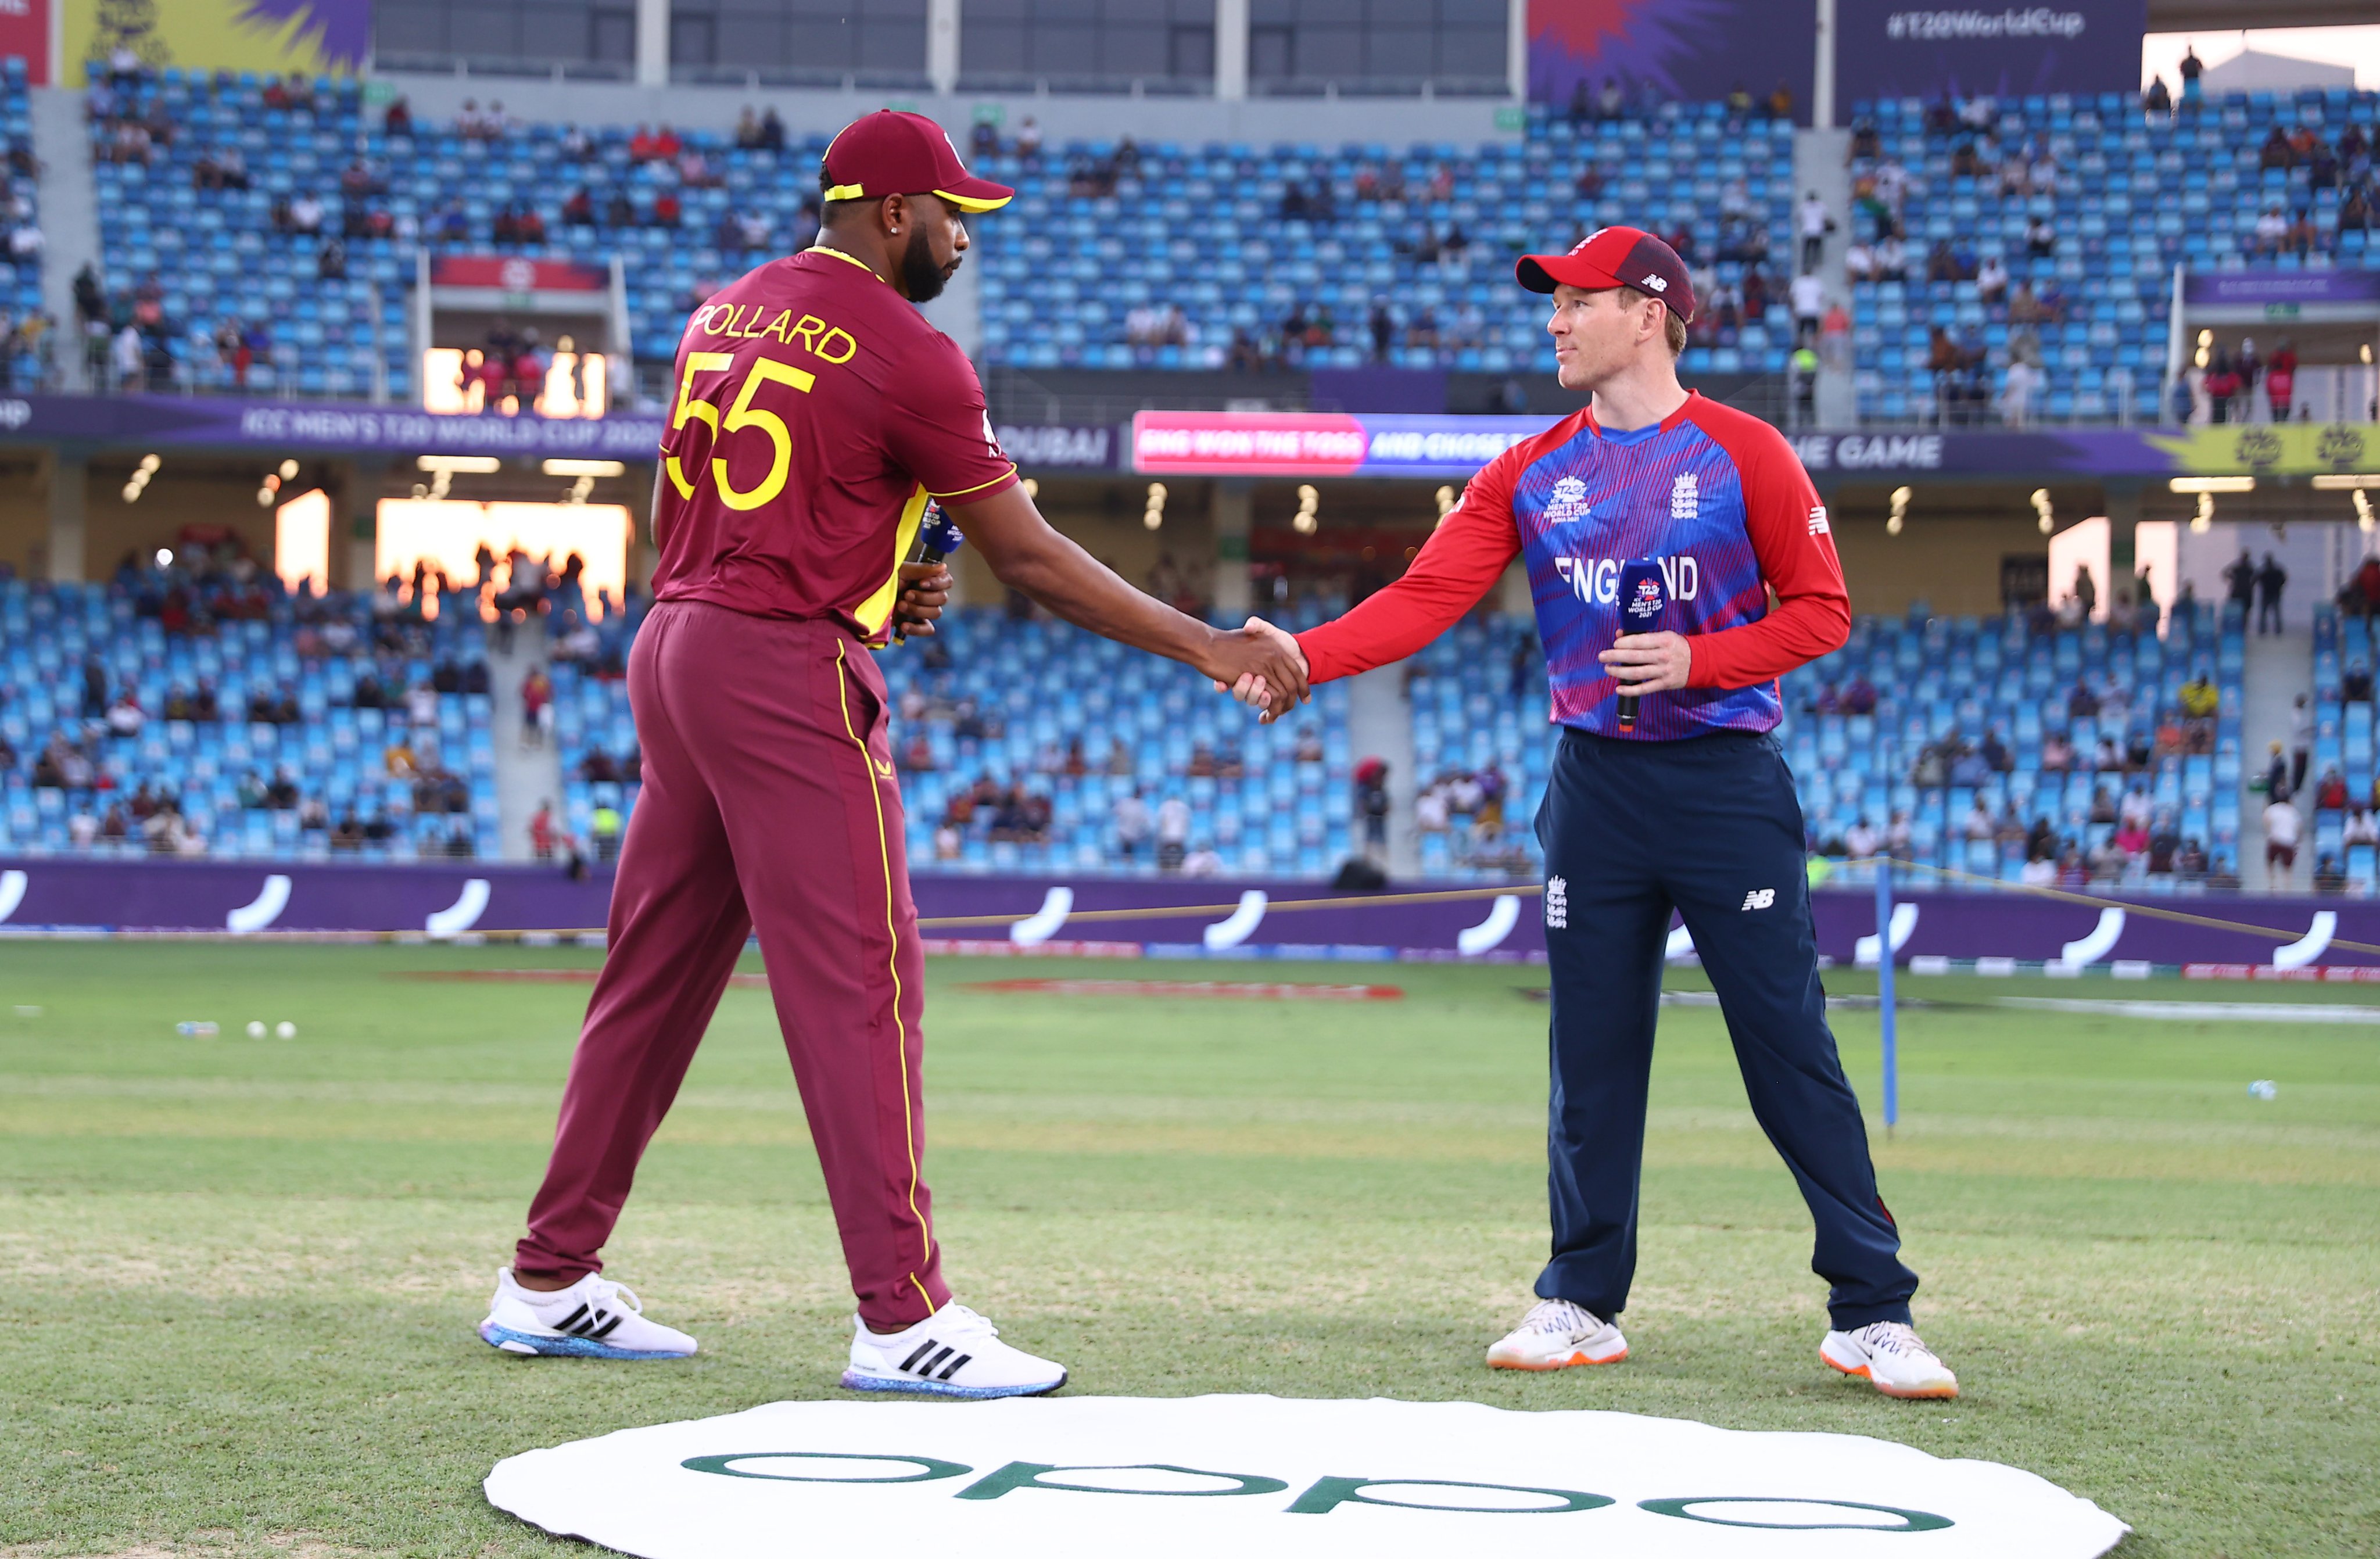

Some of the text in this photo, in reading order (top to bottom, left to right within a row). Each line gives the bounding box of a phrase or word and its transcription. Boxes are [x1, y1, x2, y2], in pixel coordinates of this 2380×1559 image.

[1887, 8, 2085, 38] #T20WorldCup
[687, 303, 857, 364] POLLARD
[241, 408, 289, 437] ICC
[292, 410, 380, 443] MEN'S
[382, 413, 433, 445] T20
[436, 414, 541, 447] WORLD
[542, 418, 603, 450] CUP
[666, 352, 816, 510] 55
[996, 425, 1108, 464] DUBAI
[1194, 429, 1254, 458] WON
[1255, 430, 1300, 458] THE
[1303, 431, 1365, 459] TOSS
[1835, 435, 1944, 469] GAME
[1543, 508, 1591, 519] WORLD CUP
[1547, 503, 1572, 511] MEN'S
[1555, 556, 1698, 604] ENGND
[1638, 585, 1660, 596] T20
[1741, 888, 1775, 911] NB
[680, 1452, 1955, 1532] oppo
